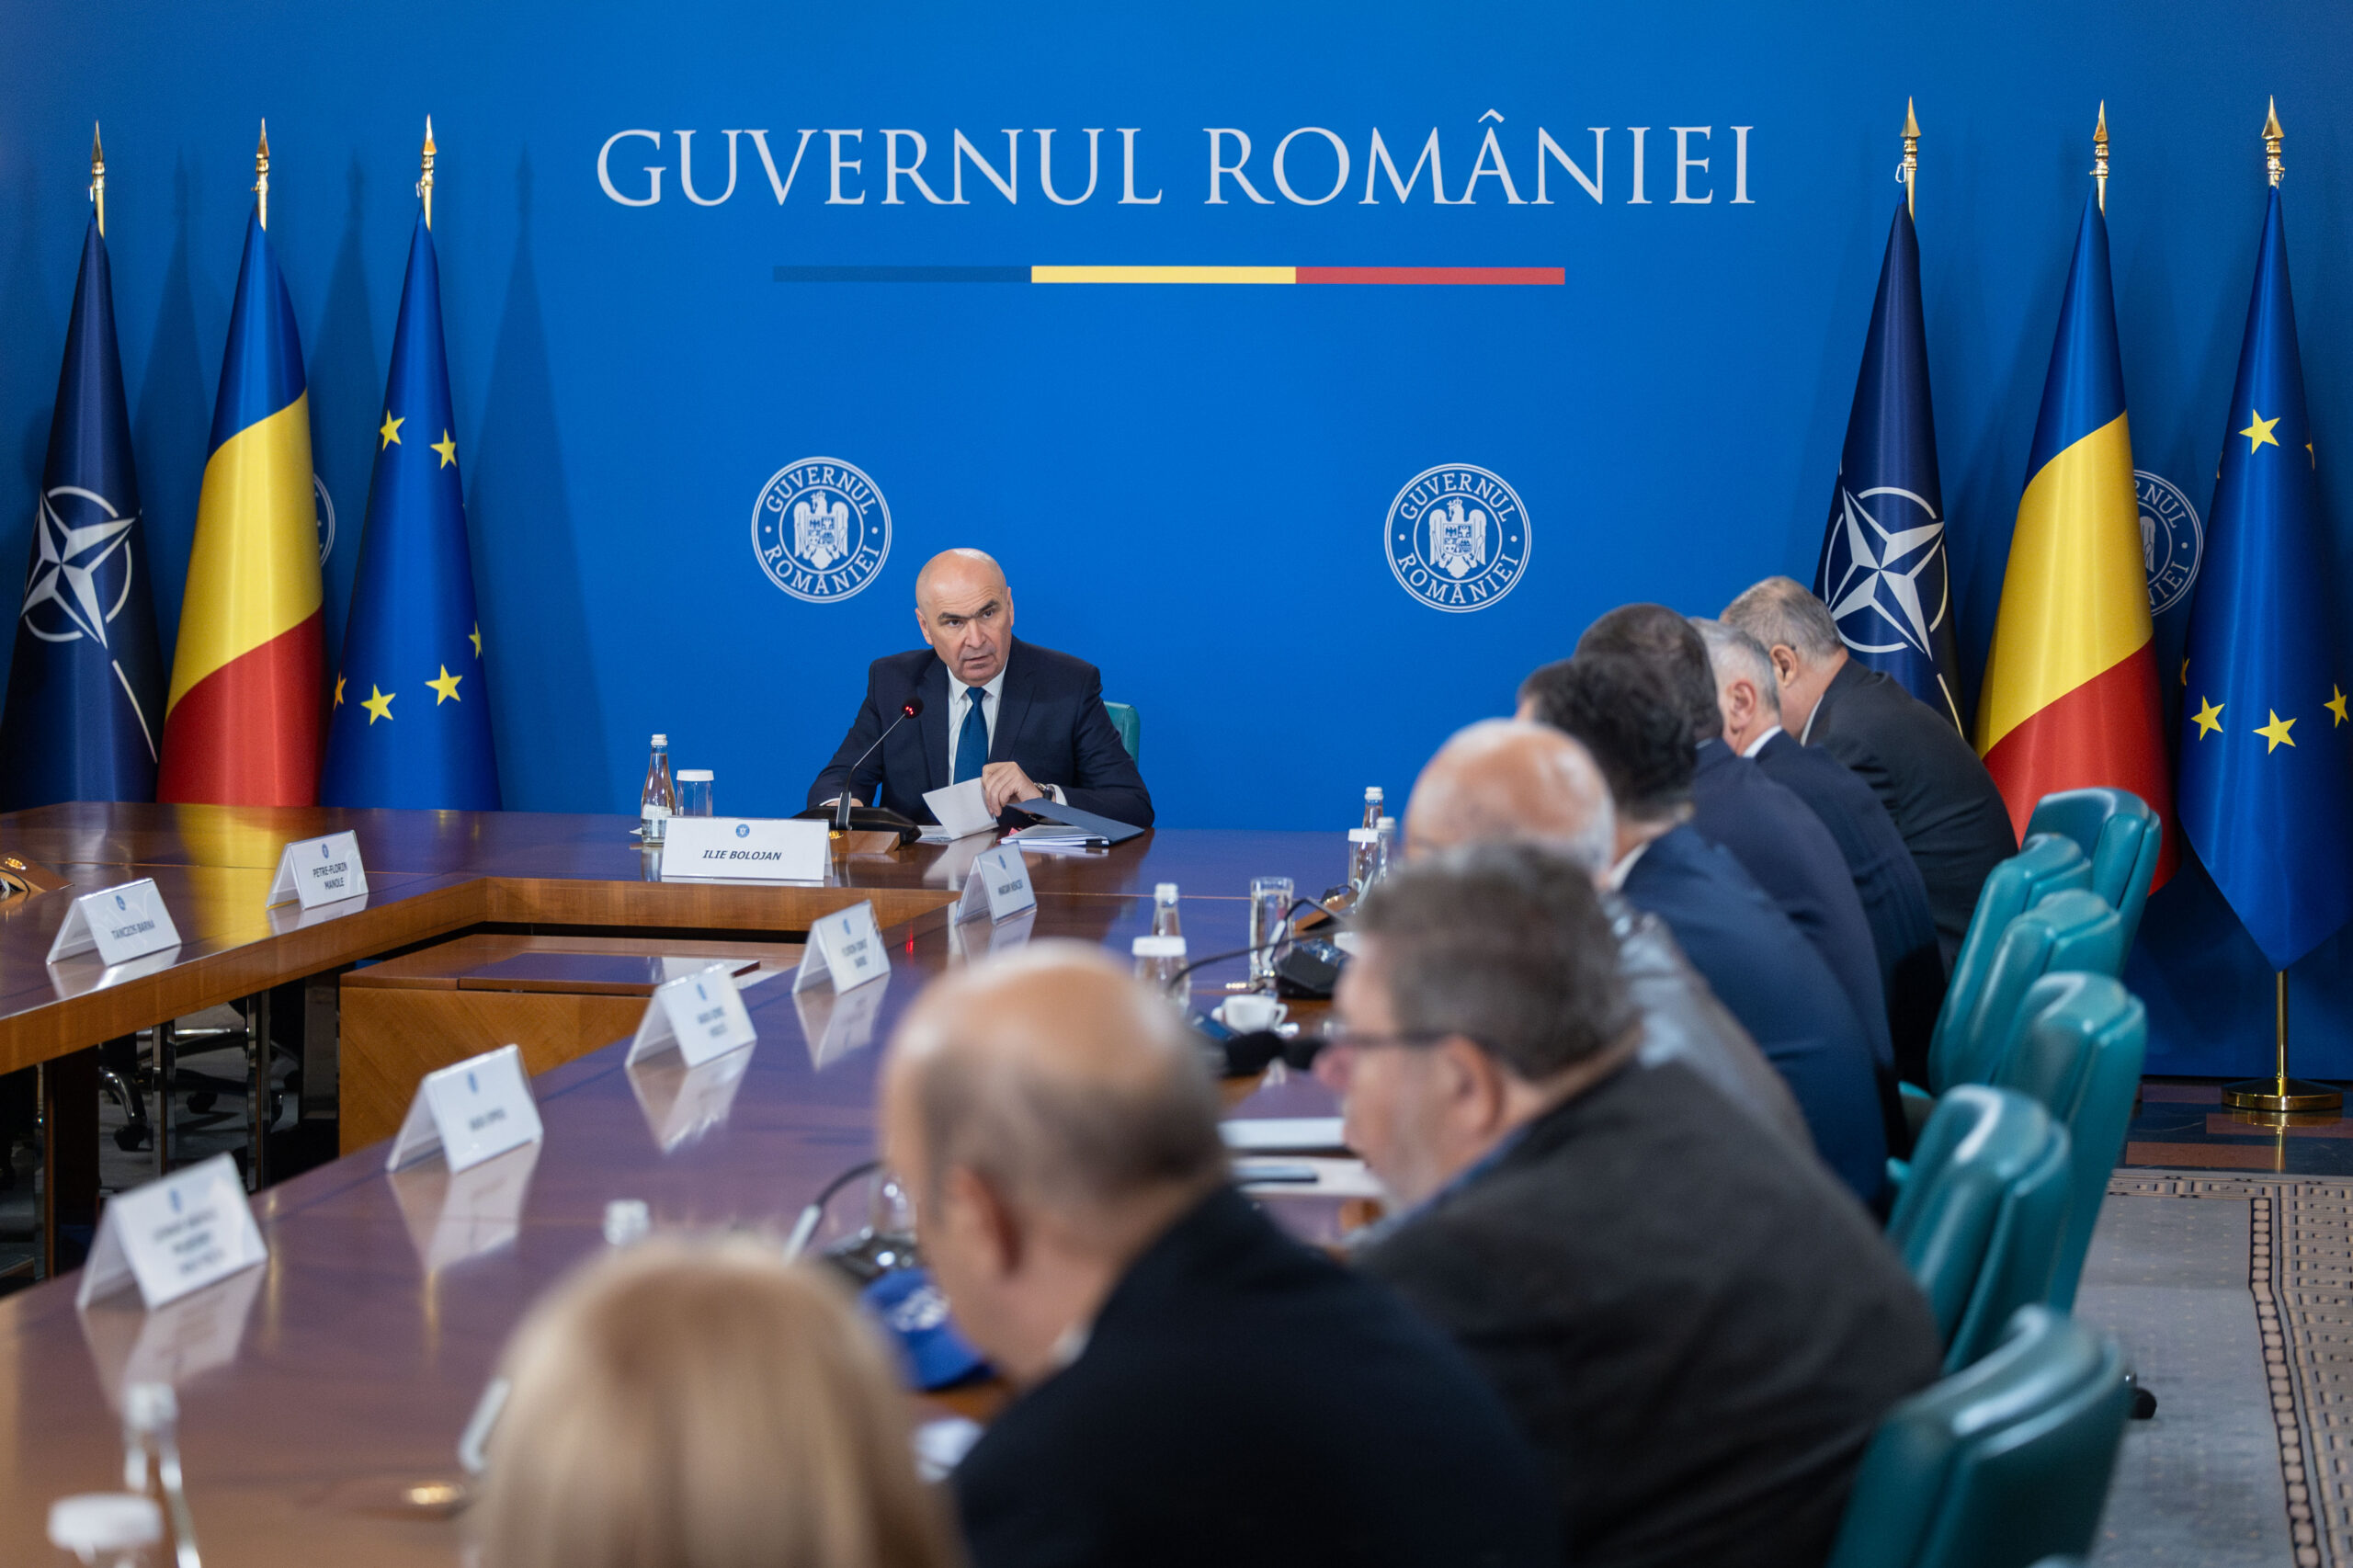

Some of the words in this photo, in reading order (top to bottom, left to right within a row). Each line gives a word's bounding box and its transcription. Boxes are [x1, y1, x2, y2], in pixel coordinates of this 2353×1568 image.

[597, 128, 1163, 208] GUVERNUL
[1204, 108, 1756, 207] ROMÂNIEI
[766, 466, 876, 515] GUVERNUL
[1400, 472, 1516, 522] GUVERNUL
[765, 544, 880, 594] ROMÂNIEI
[1397, 552, 1518, 604] ROMÂNIEI
[702, 849, 727, 859] ILIE
[729, 850, 782, 861] BOLOJAN
